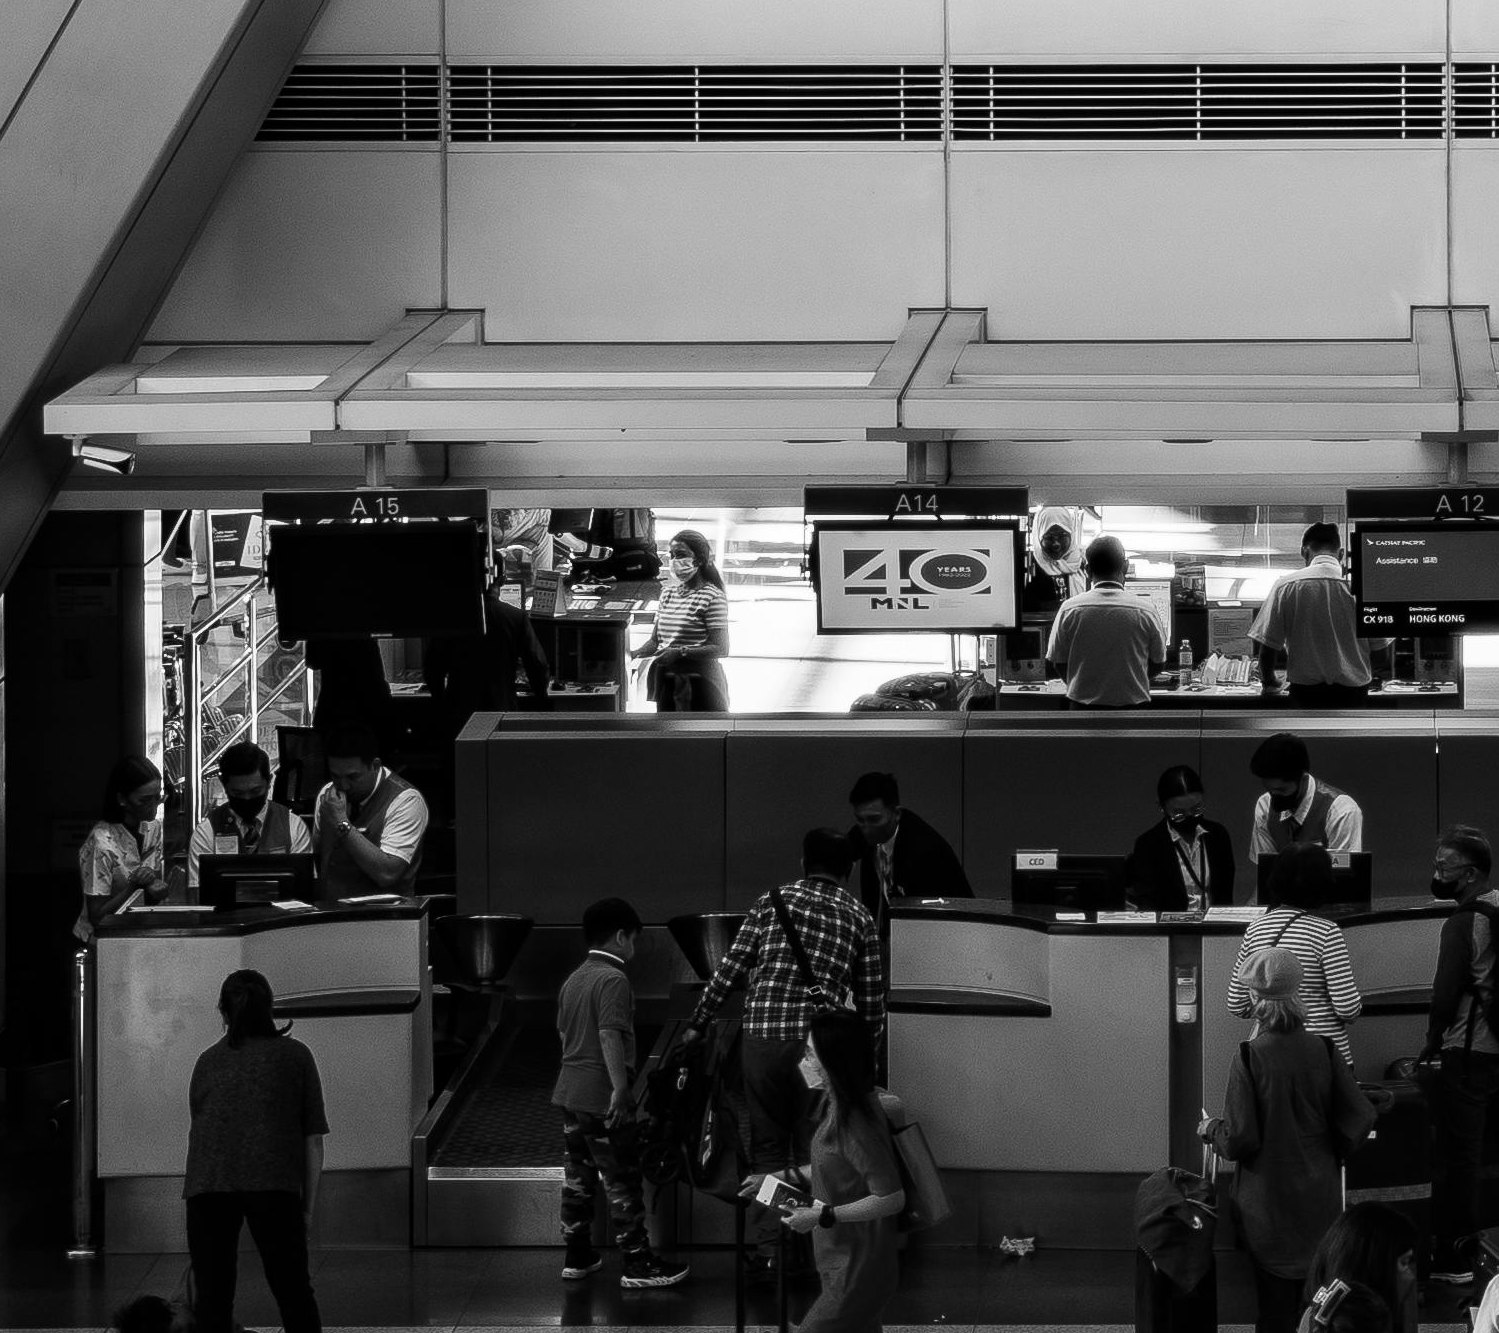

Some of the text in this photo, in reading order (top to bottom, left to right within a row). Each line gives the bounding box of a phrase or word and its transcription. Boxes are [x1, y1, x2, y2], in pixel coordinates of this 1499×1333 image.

[350, 497, 399, 515] A 15
[895, 494, 939, 512] A14
[1436, 494, 1485, 513] A 12
[1375, 556, 1419, 564] Assistance
[1363, 615, 1376, 624] CX
[1409, 614, 1465, 623] HONG KONG
